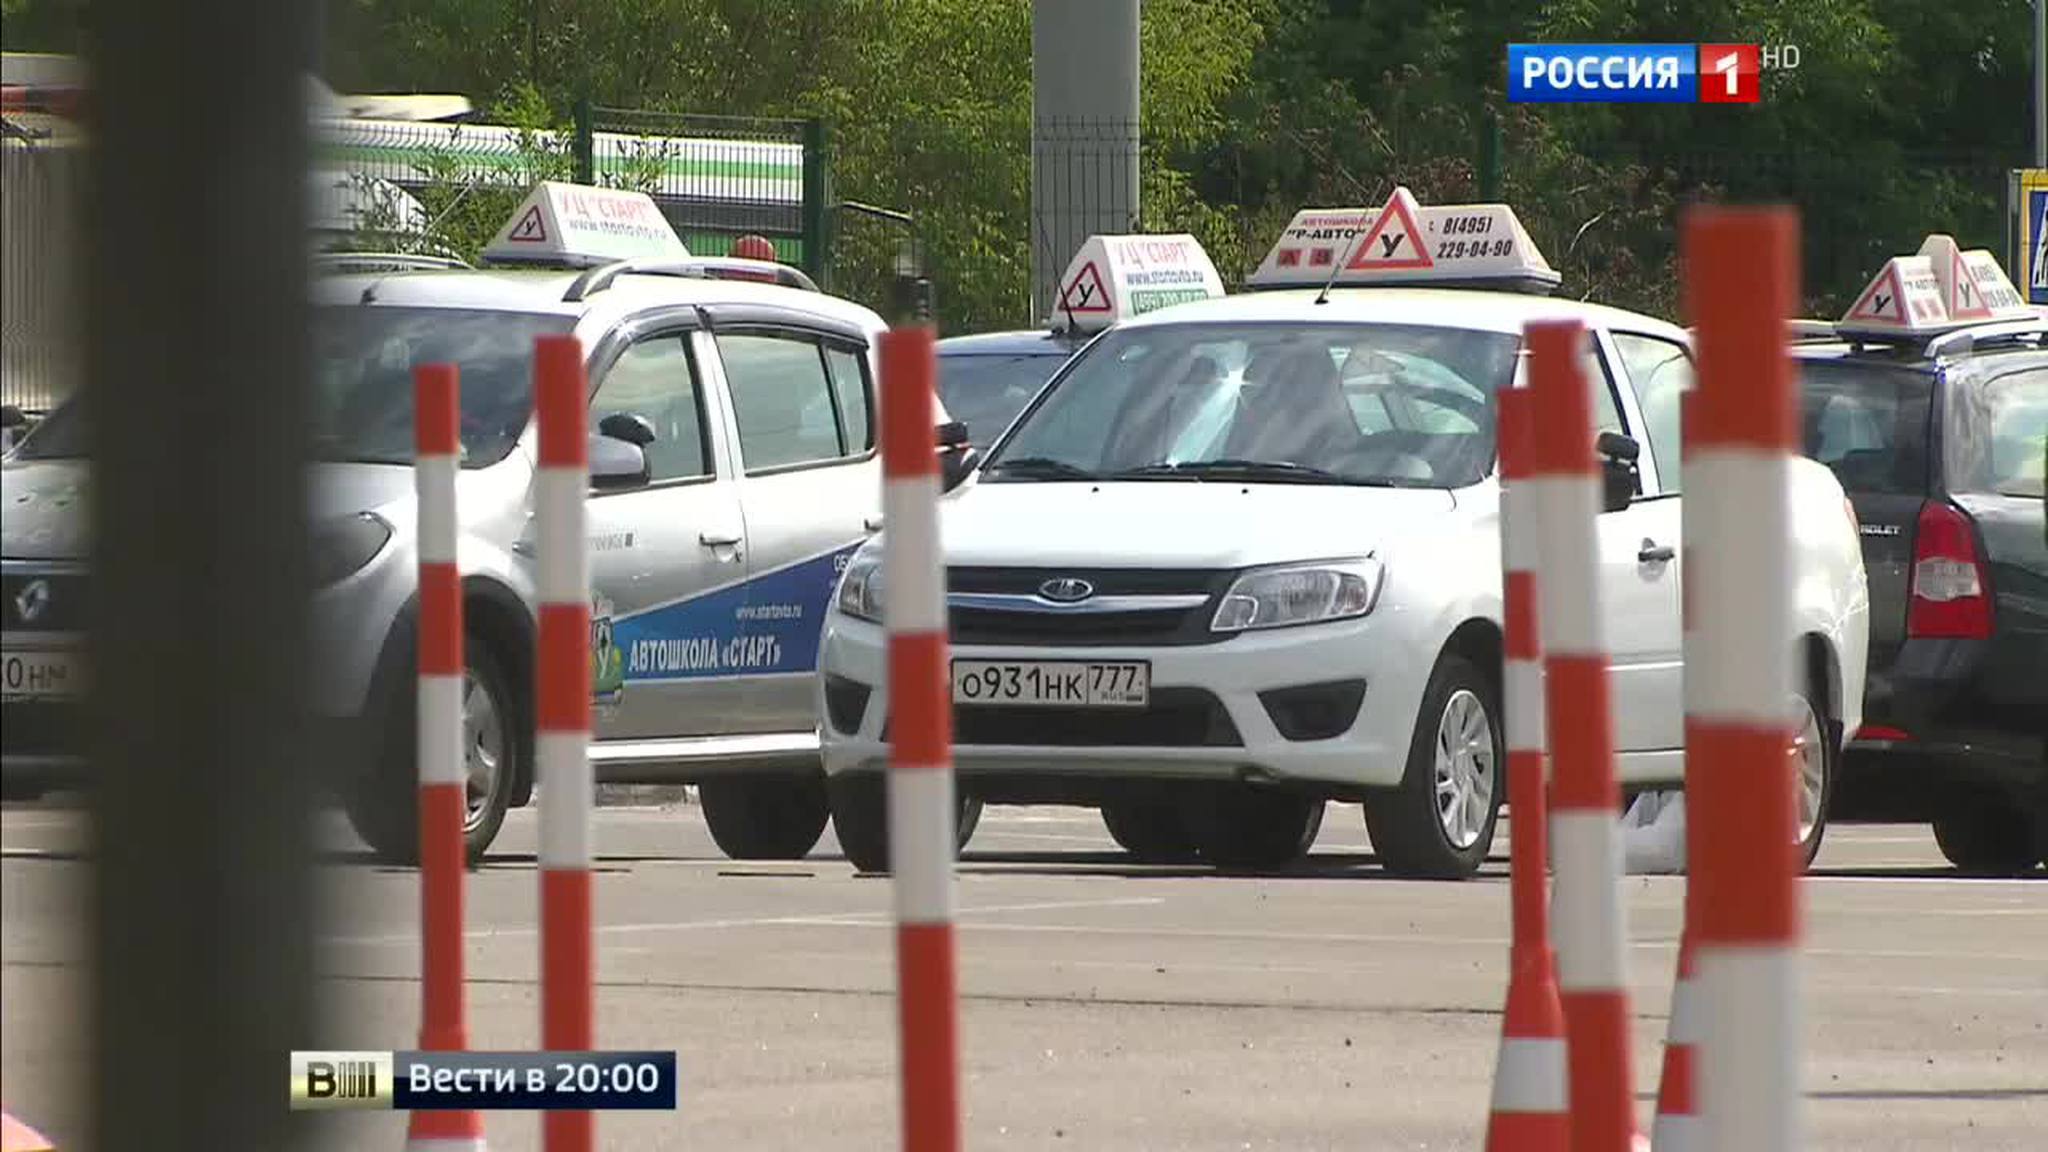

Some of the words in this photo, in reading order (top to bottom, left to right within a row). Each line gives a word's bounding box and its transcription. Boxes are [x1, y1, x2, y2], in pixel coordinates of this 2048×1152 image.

[1437, 239, 1513, 259] 229-04-90
[628, 638, 719, 672] АВТОШКОЛА
[721, 635, 782, 667] «СТАРТ»
[1091, 665, 1138, 691] 777
